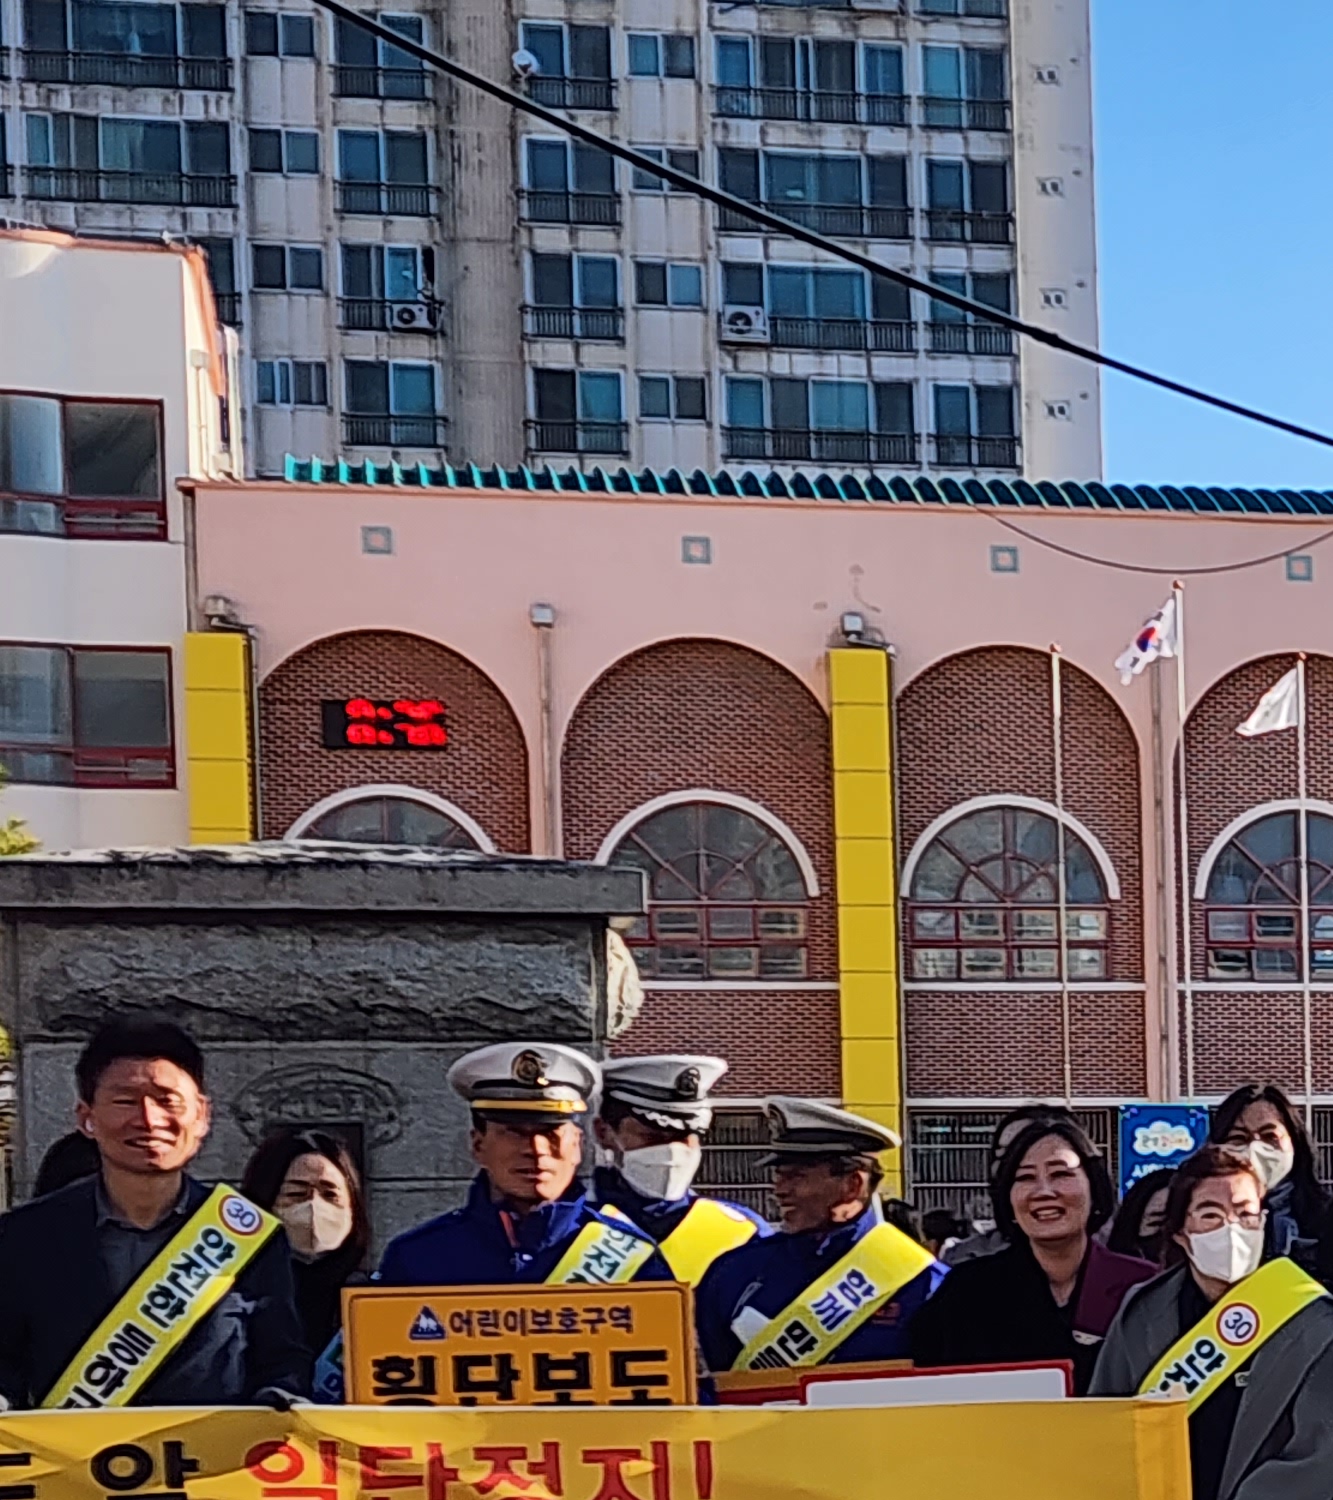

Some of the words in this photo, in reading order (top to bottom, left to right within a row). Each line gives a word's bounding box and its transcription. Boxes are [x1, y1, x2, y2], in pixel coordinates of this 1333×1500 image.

[226, 1201, 256, 1228] 30
[139, 1227, 237, 1329] 안전한
[810, 1268, 879, 1332] 함께
[449, 1304, 634, 1338] 어린이보호구역
[1224, 1311, 1253, 1340] 30
